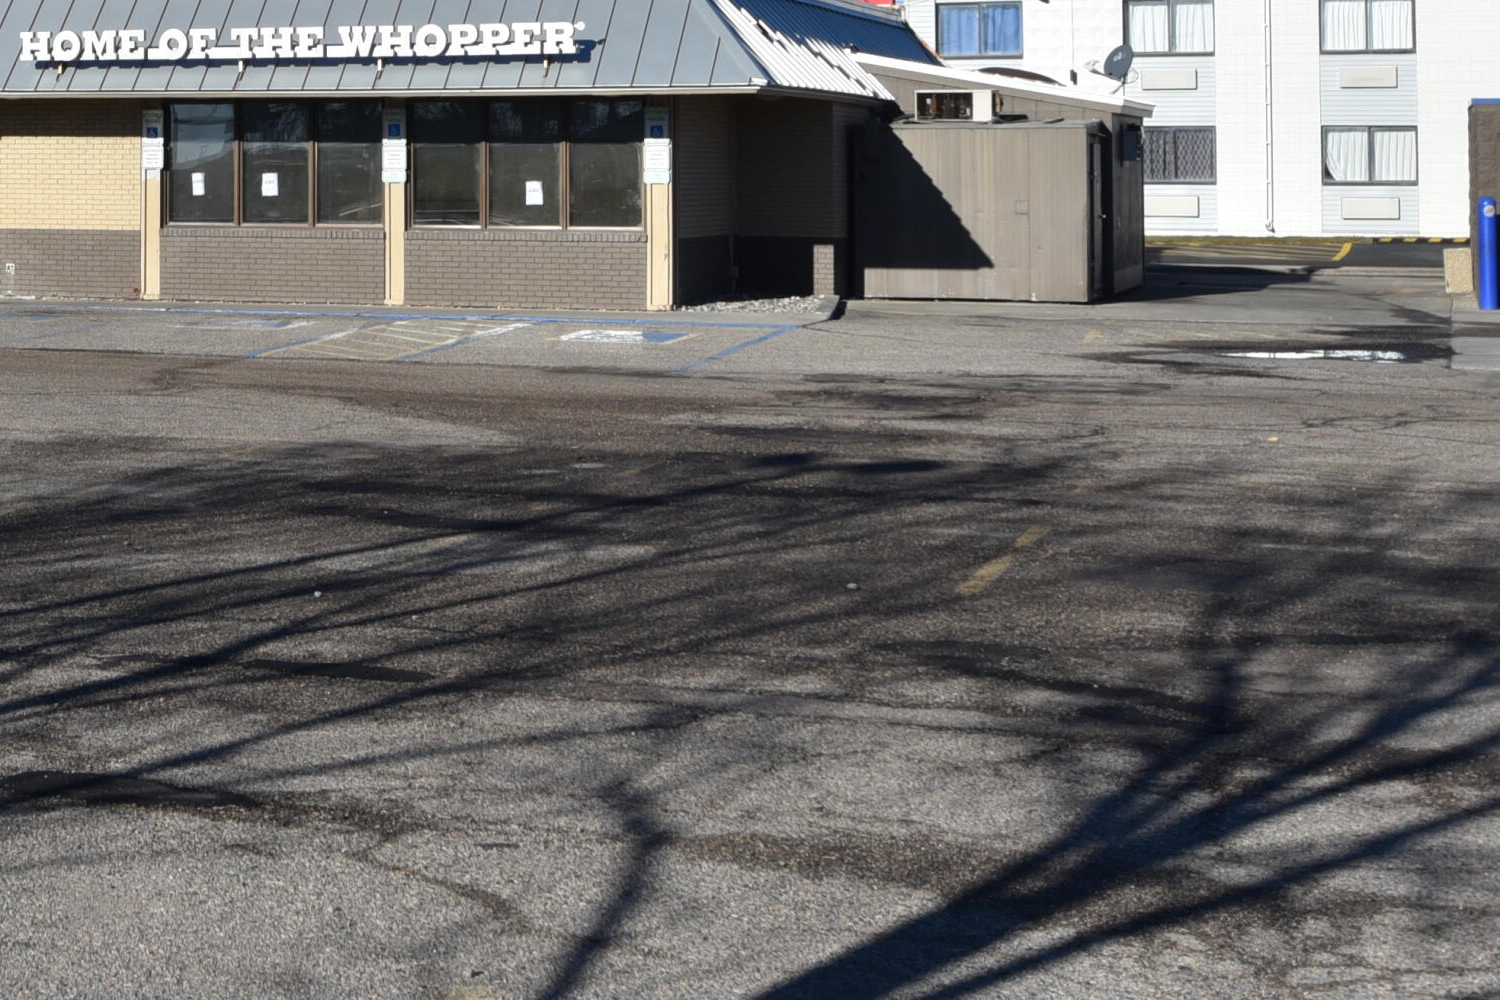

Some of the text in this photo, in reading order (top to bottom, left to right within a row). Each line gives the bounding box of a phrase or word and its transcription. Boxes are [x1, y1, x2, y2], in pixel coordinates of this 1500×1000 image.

[19, 22, 578, 62] HOME OF THE WHOPPER
